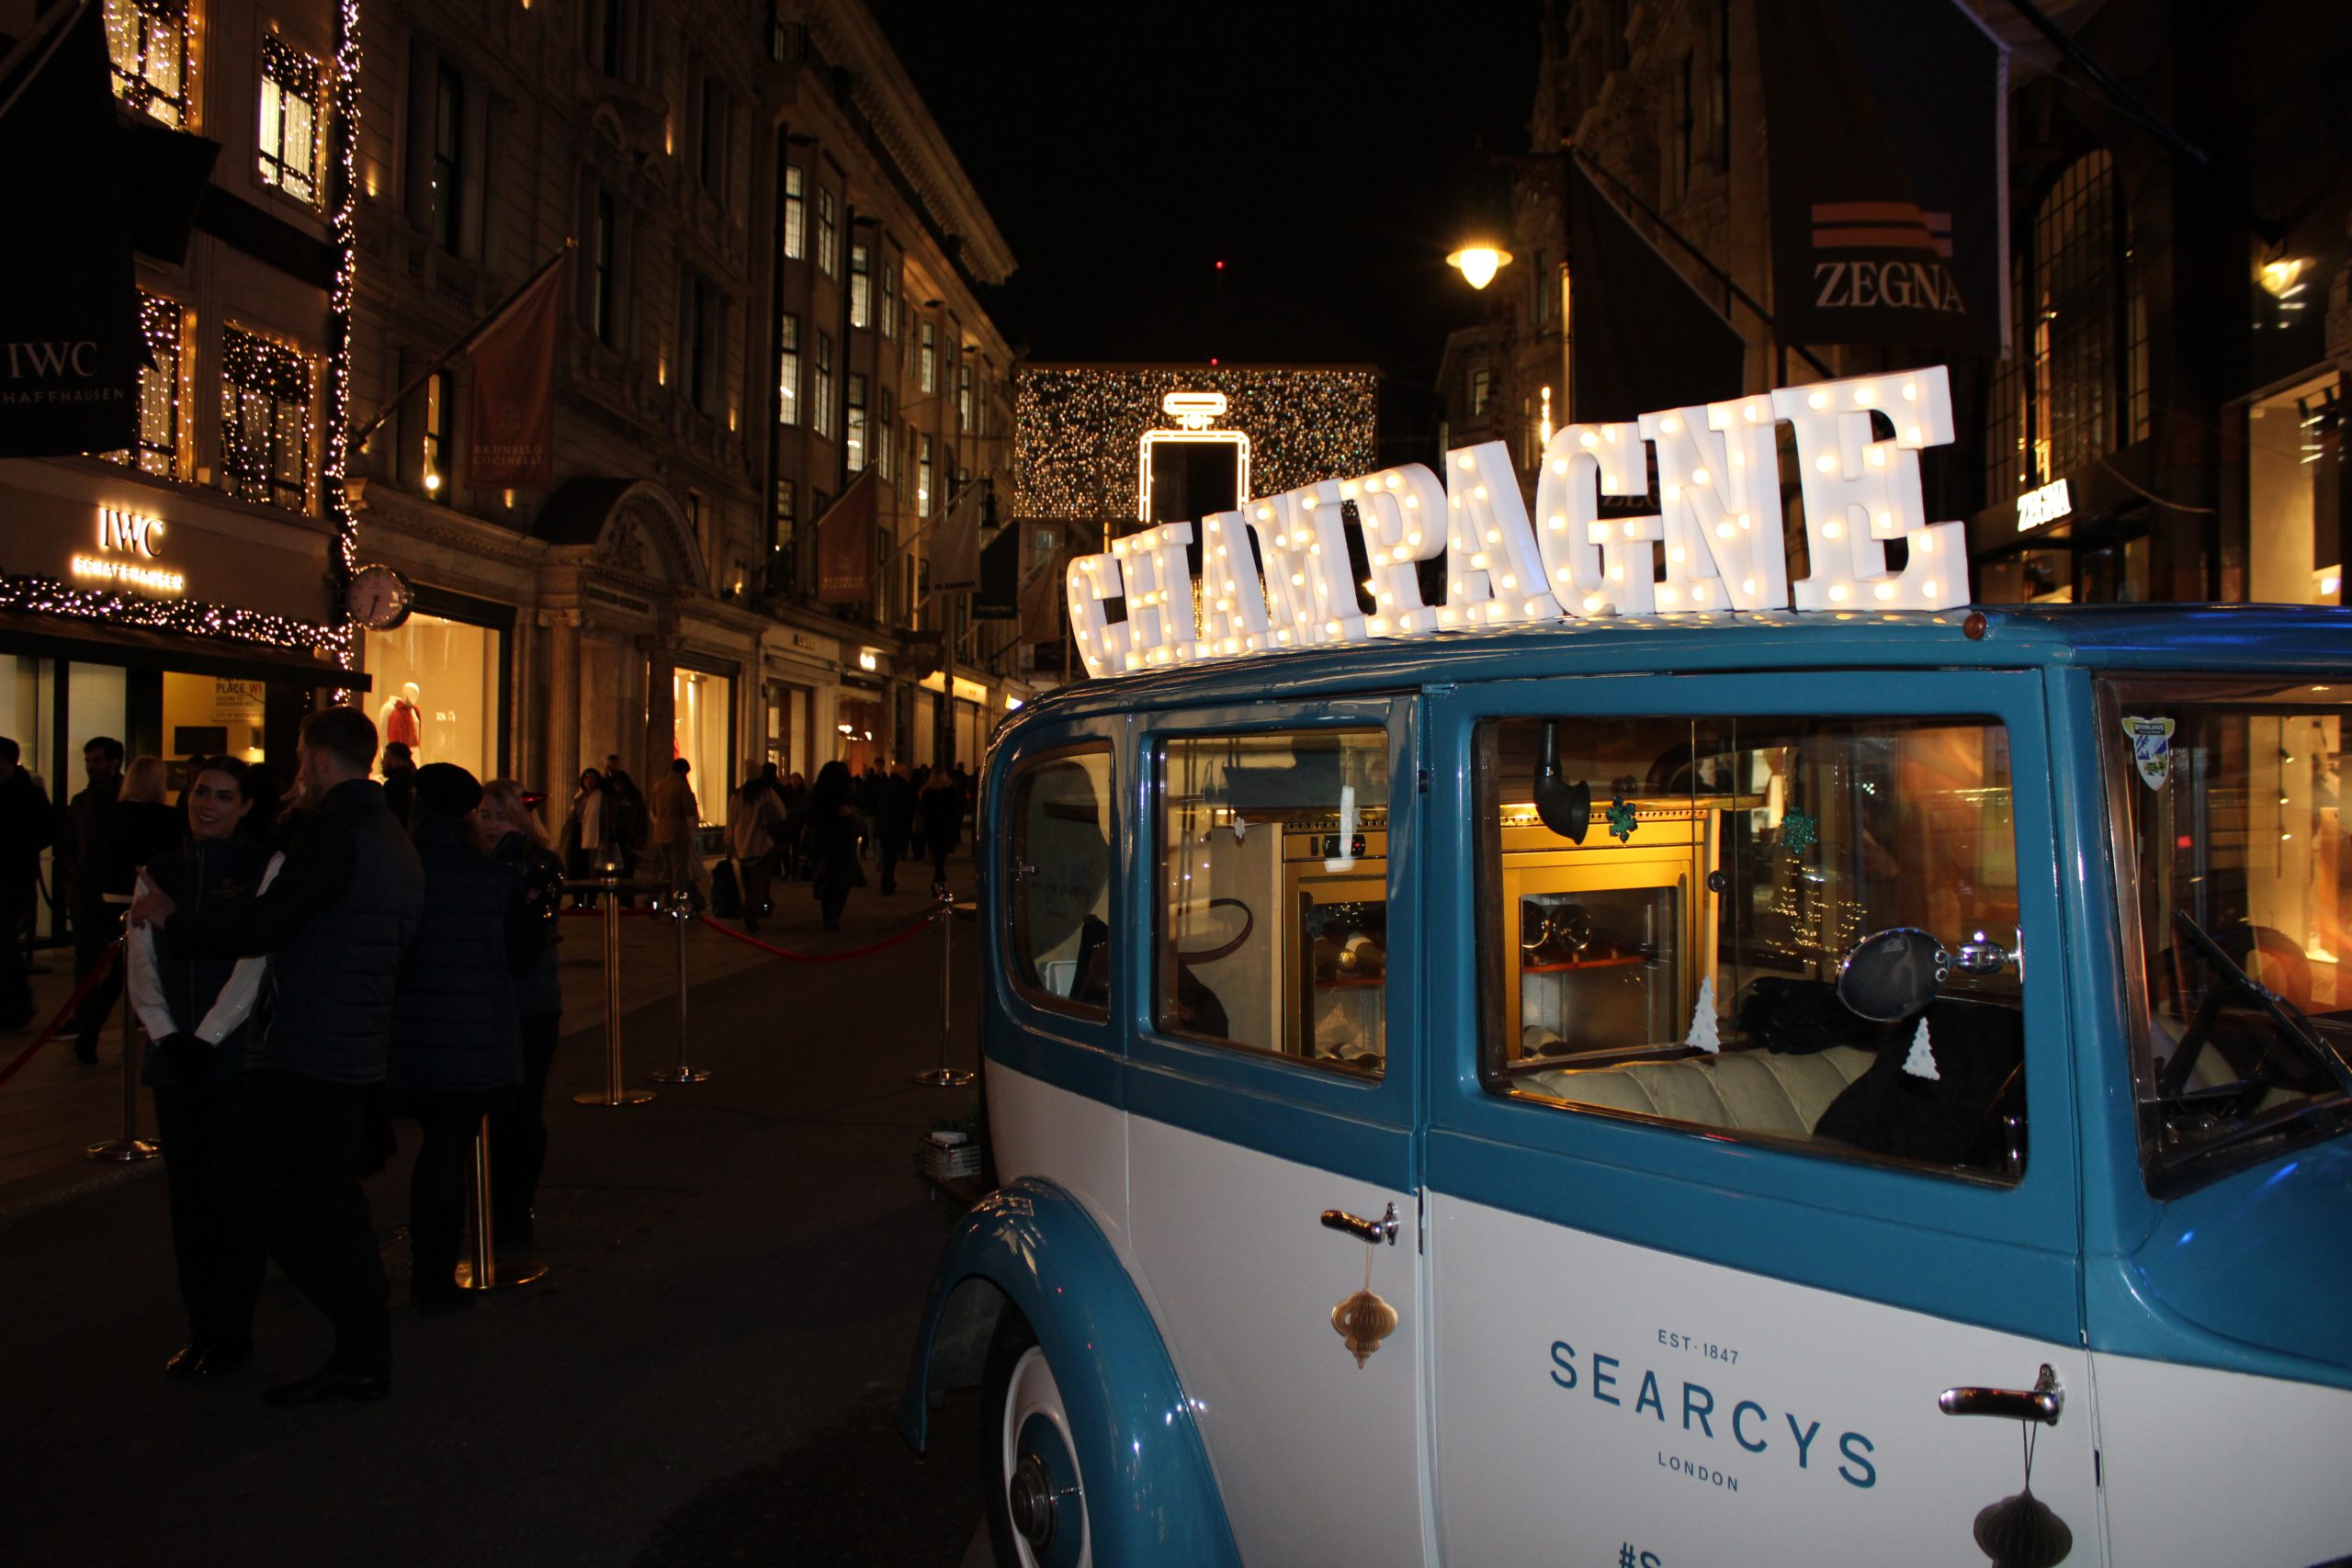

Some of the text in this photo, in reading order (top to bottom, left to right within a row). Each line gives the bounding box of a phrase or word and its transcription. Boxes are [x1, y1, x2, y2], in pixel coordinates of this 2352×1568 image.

[1814, 261, 1966, 314] ZEGNA
[6, 341, 98, 379] IWC
[97, 505, 164, 558] IWC
[1067, 365, 1970, 679] CHAMPAGNE
[216, 682, 263, 694] PLACE W1
[1550, 1340, 1877, 1489] SEARCYS
[1657, 1451, 1739, 1492] LONDON
